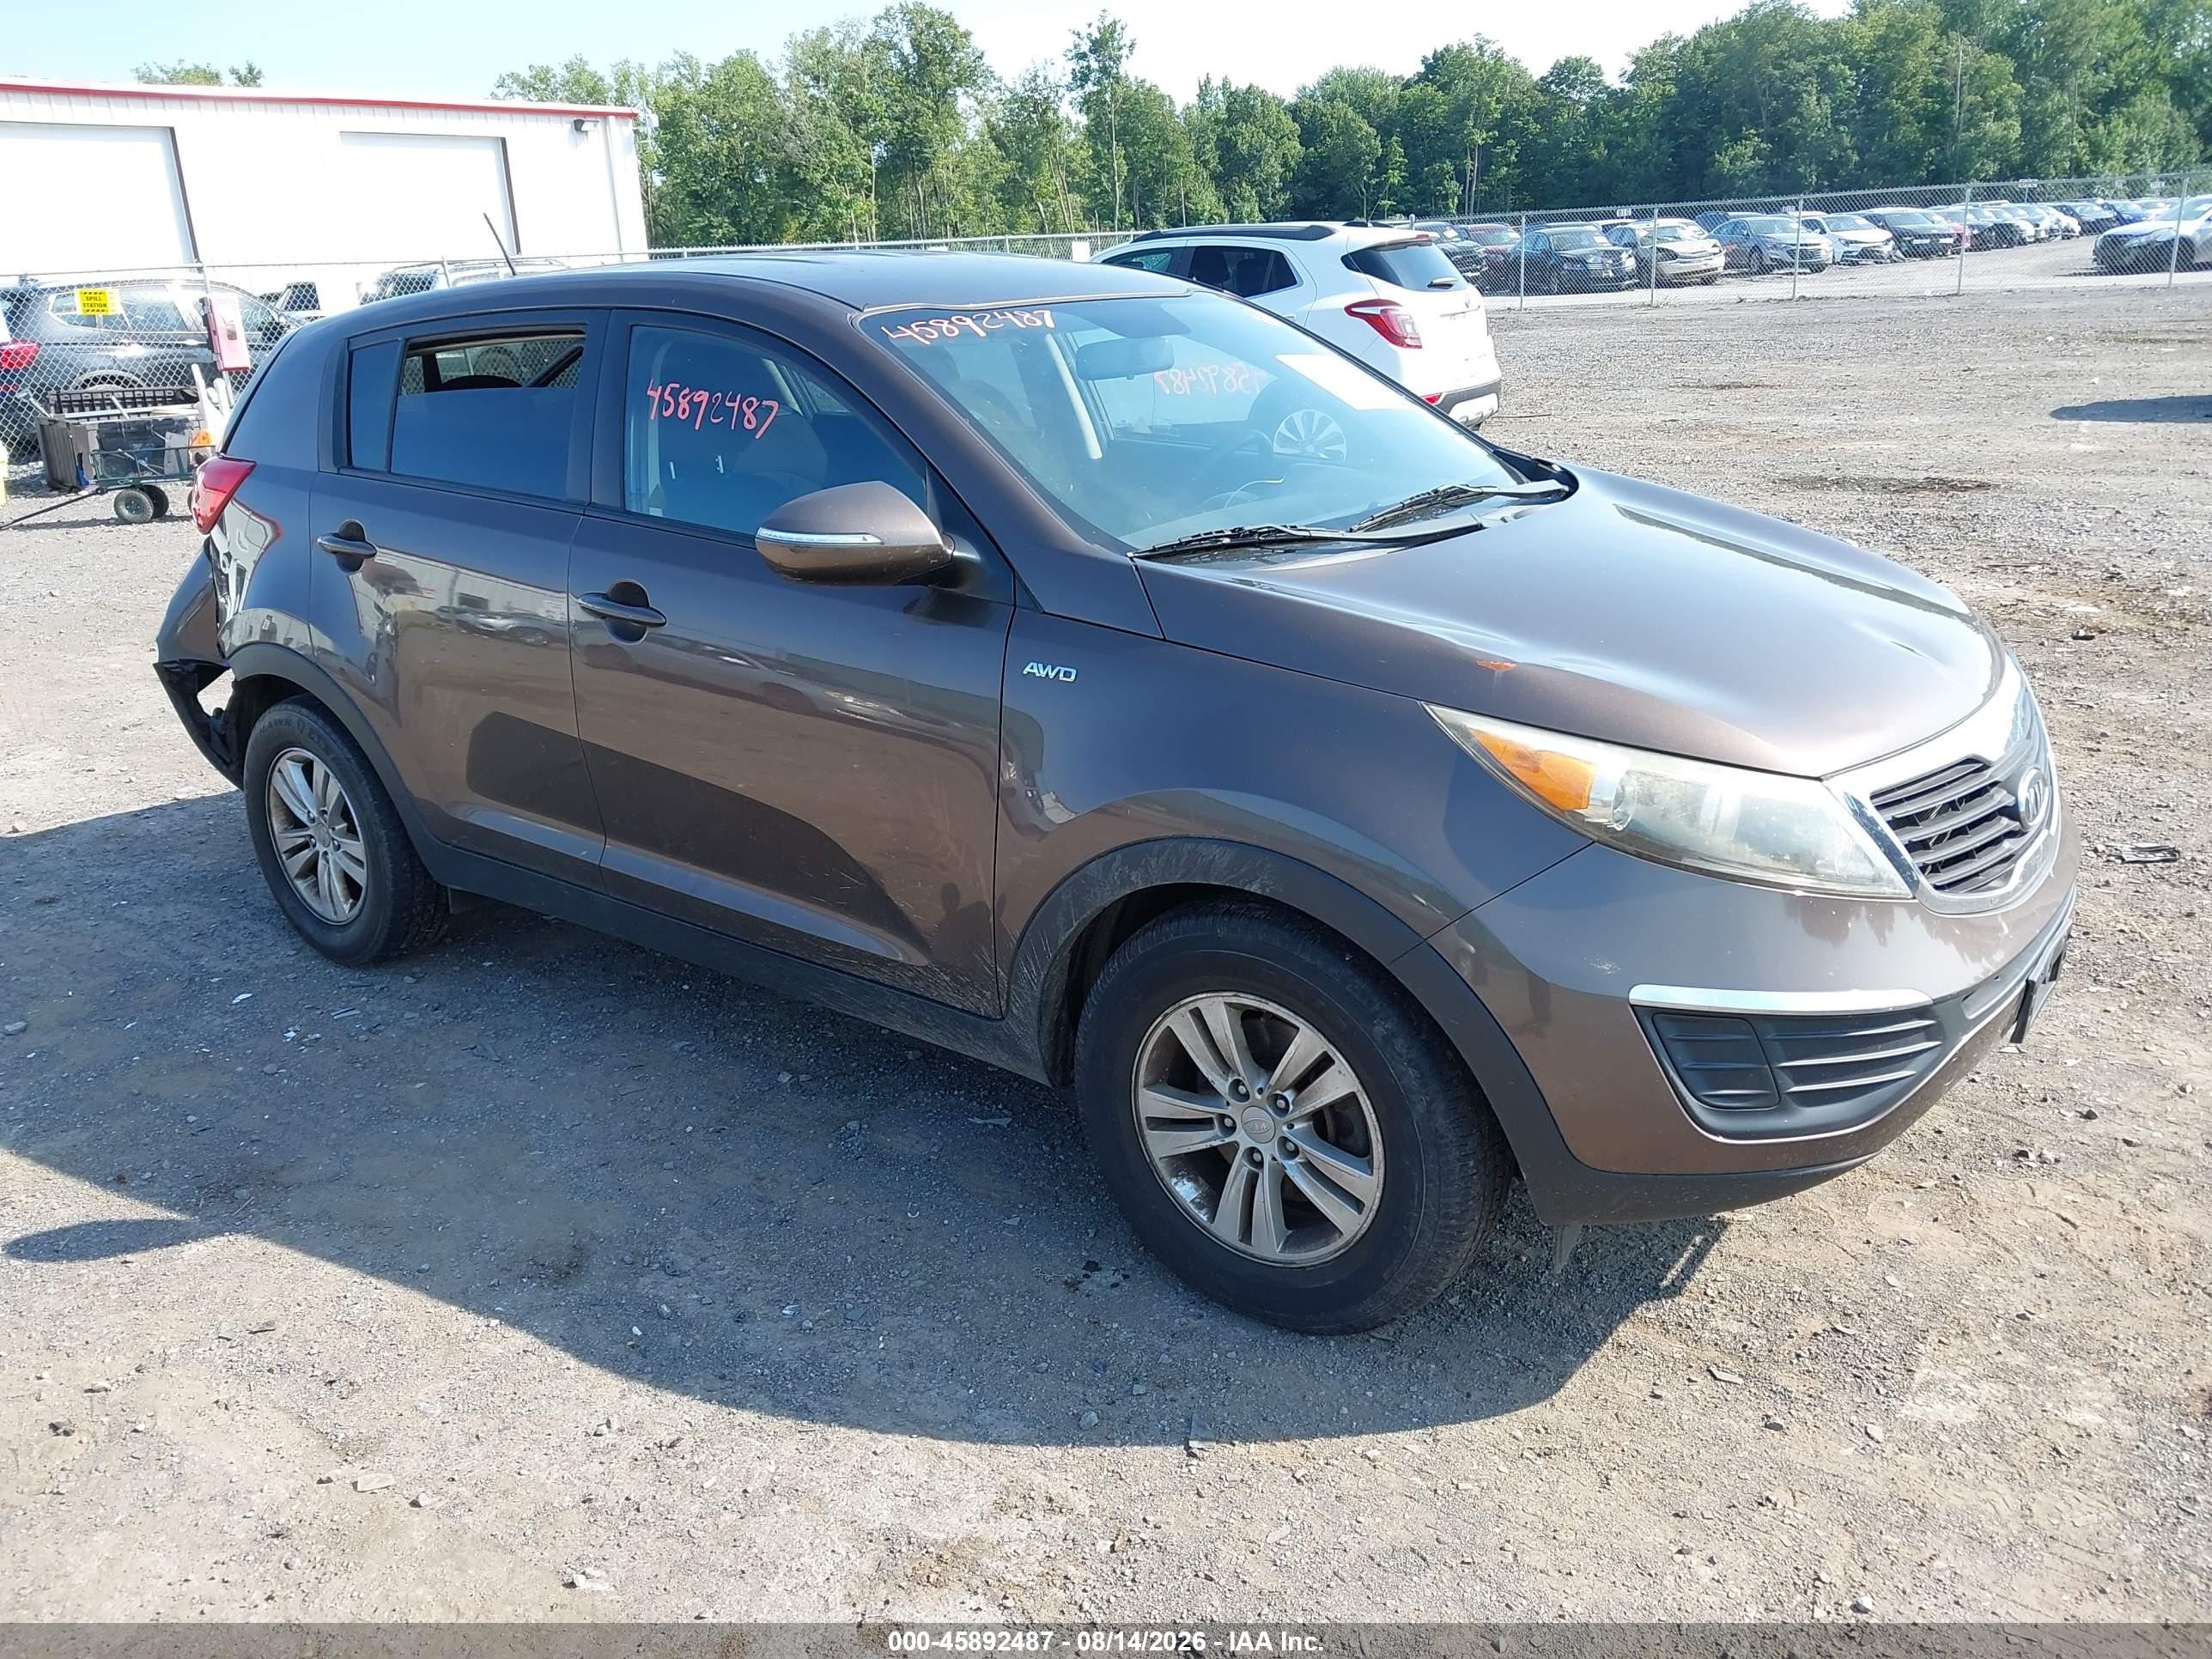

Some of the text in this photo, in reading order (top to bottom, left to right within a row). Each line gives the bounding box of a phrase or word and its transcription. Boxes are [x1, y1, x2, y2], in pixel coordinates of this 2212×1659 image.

[881, 309, 1054, 345] 45892487
[647, 378, 779, 440] 45892487
[1023, 660, 1077, 682] AWD
